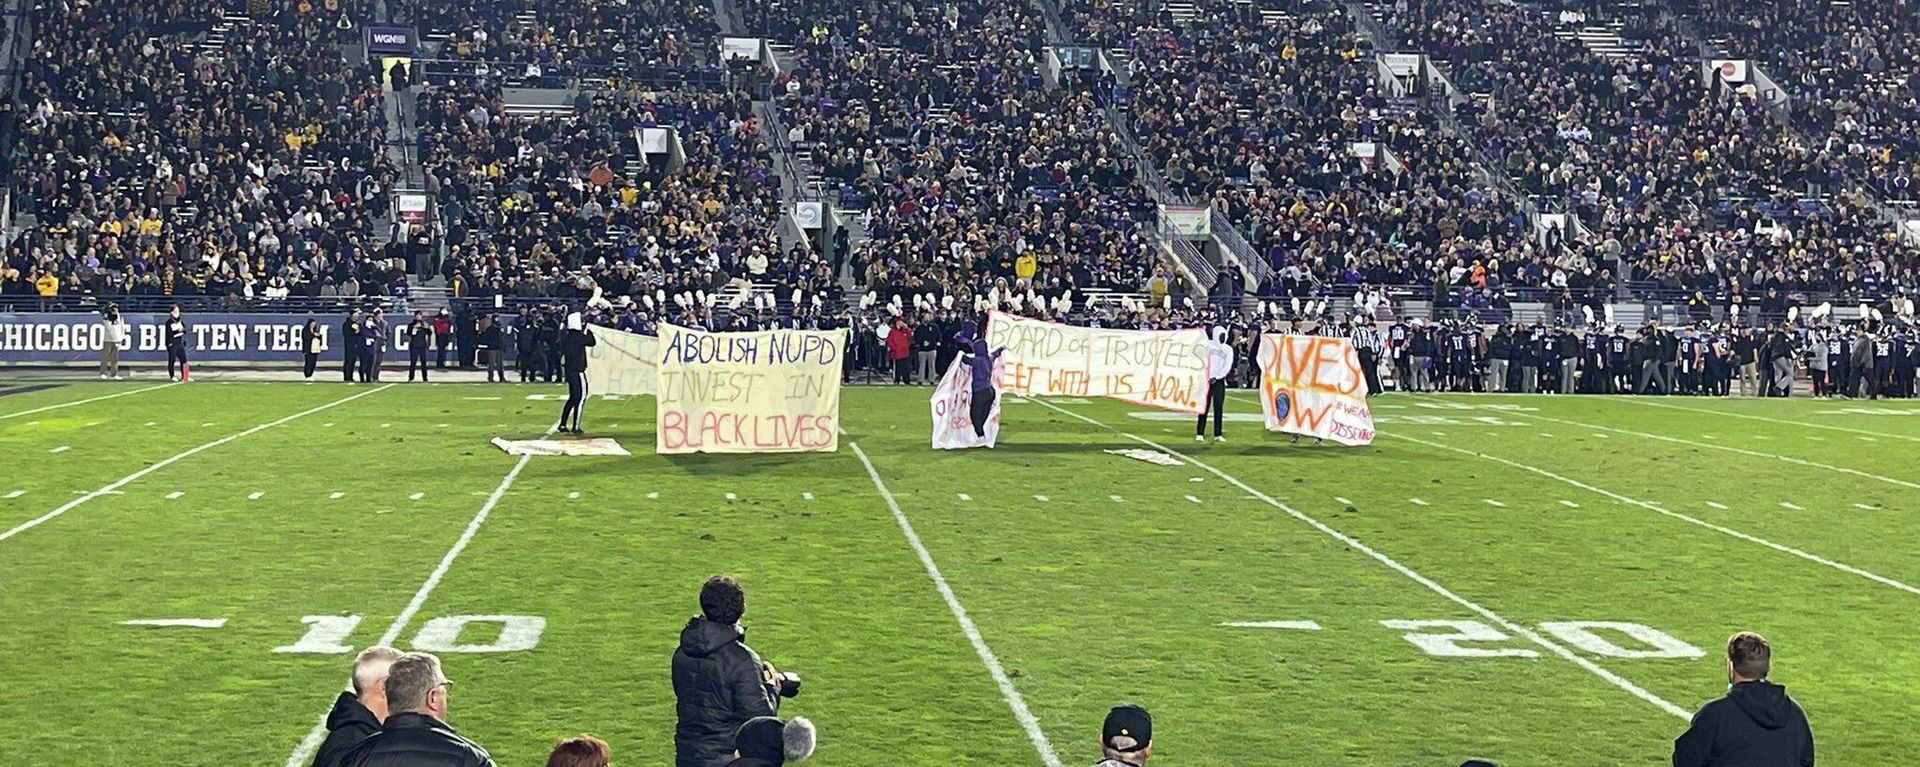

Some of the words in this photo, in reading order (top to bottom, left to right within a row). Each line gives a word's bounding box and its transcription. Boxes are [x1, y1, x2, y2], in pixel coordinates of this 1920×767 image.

[374, 34, 396, 44] WGN
[0, 323, 131, 351] HICAGOS
[192, 323, 247, 351] TEN
[662, 330, 758, 365] ABOLISH
[769, 332, 836, 365] NUPD
[991, 318, 1064, 358] BOARD
[1098, 334, 1206, 370] TRUSTEES
[1452, 335, 1463, 350] 11
[661, 370, 764, 404] INVEST
[785, 374, 824, 399] IN
[1000, 361, 1040, 393] EET
[1048, 368, 1091, 395] WITH
[1106, 373, 1134, 395] US
[1143, 375, 1197, 408] NOW.
[664, 411, 748, 449] BLACK
[754, 414, 833, 448] LIVES
[270, 613, 547, 654] 10
[1378, 618, 1707, 659] 20
